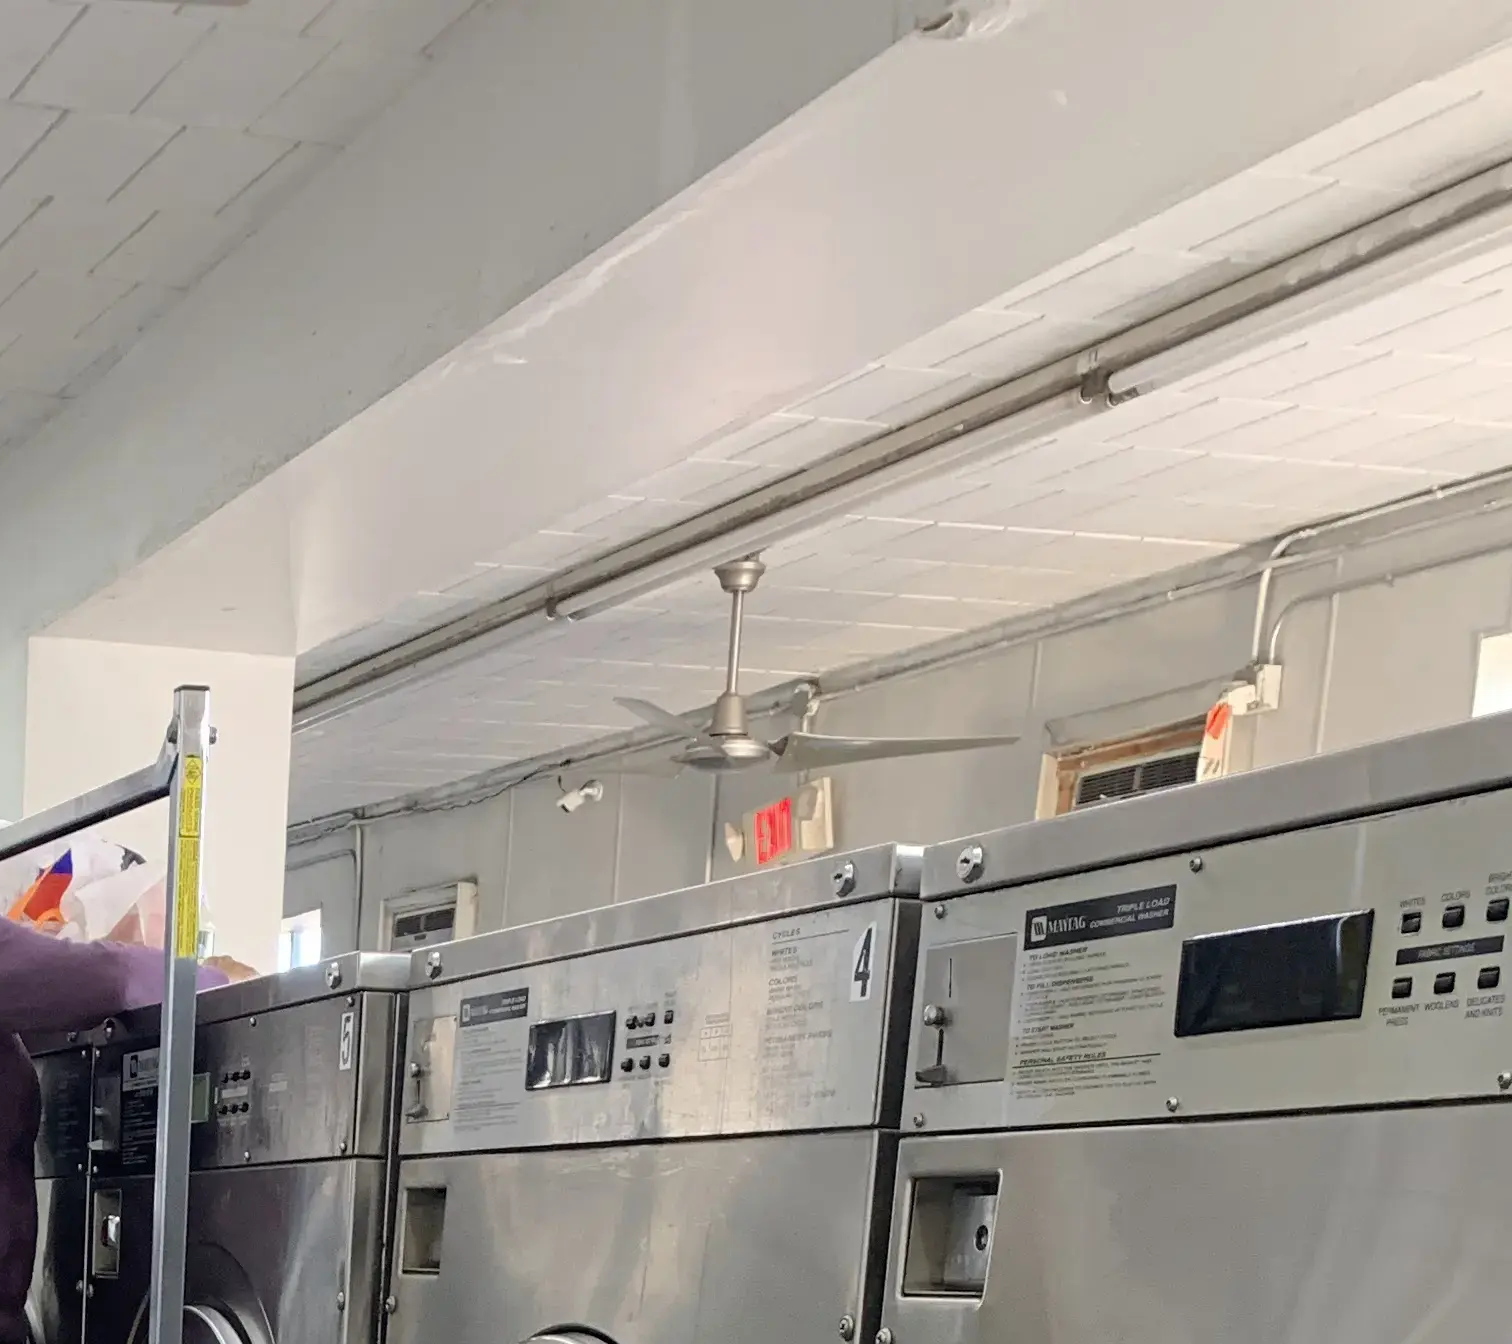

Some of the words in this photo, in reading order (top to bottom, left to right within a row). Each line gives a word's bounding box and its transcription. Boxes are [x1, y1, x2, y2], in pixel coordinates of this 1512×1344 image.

[1117, 901, 1146, 915] TRIPLE
[1146, 897, 1170, 909] LOAD
[1048, 915, 1086, 934] MAYTAG
[1090, 915, 1135, 929] COMMERCIAL
[1137, 908, 1169, 921] WASHER
[854, 927, 872, 998] 4
